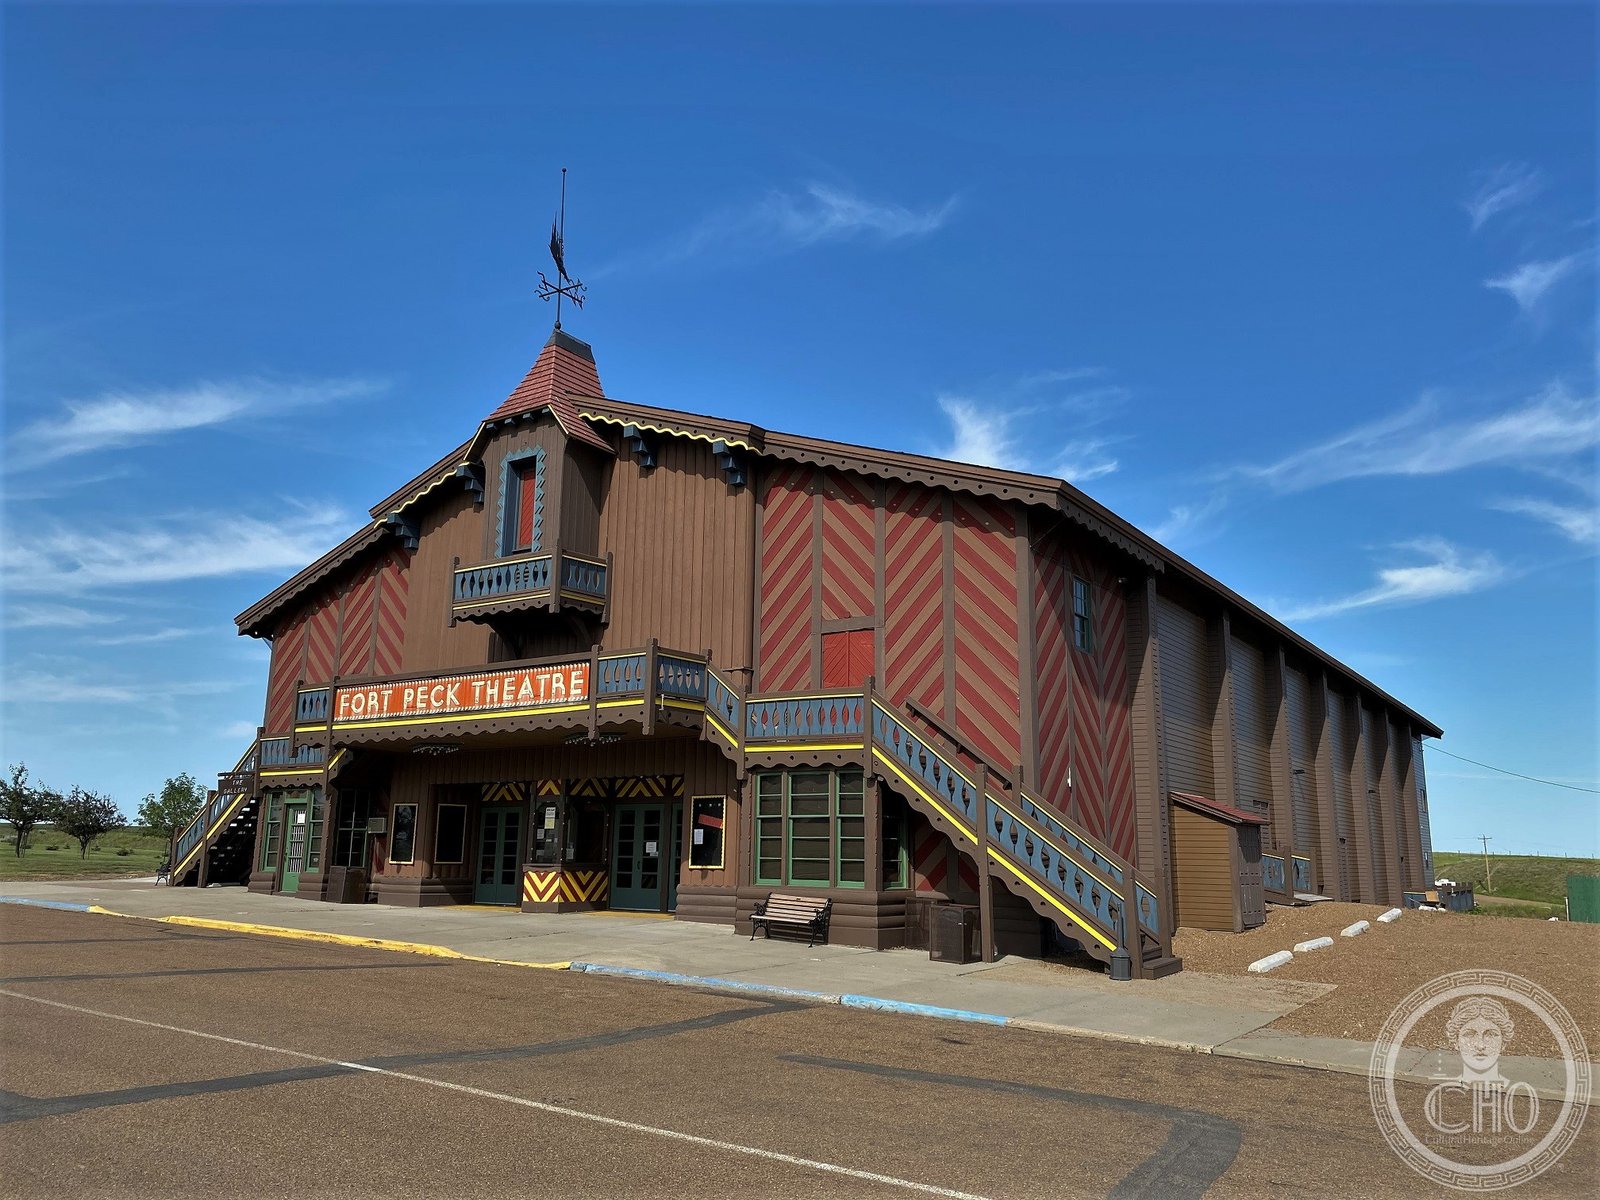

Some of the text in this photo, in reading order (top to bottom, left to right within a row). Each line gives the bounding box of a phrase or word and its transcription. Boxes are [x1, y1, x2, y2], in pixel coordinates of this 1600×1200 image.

[339, 670, 584, 715] FORT PECK THEATRE
